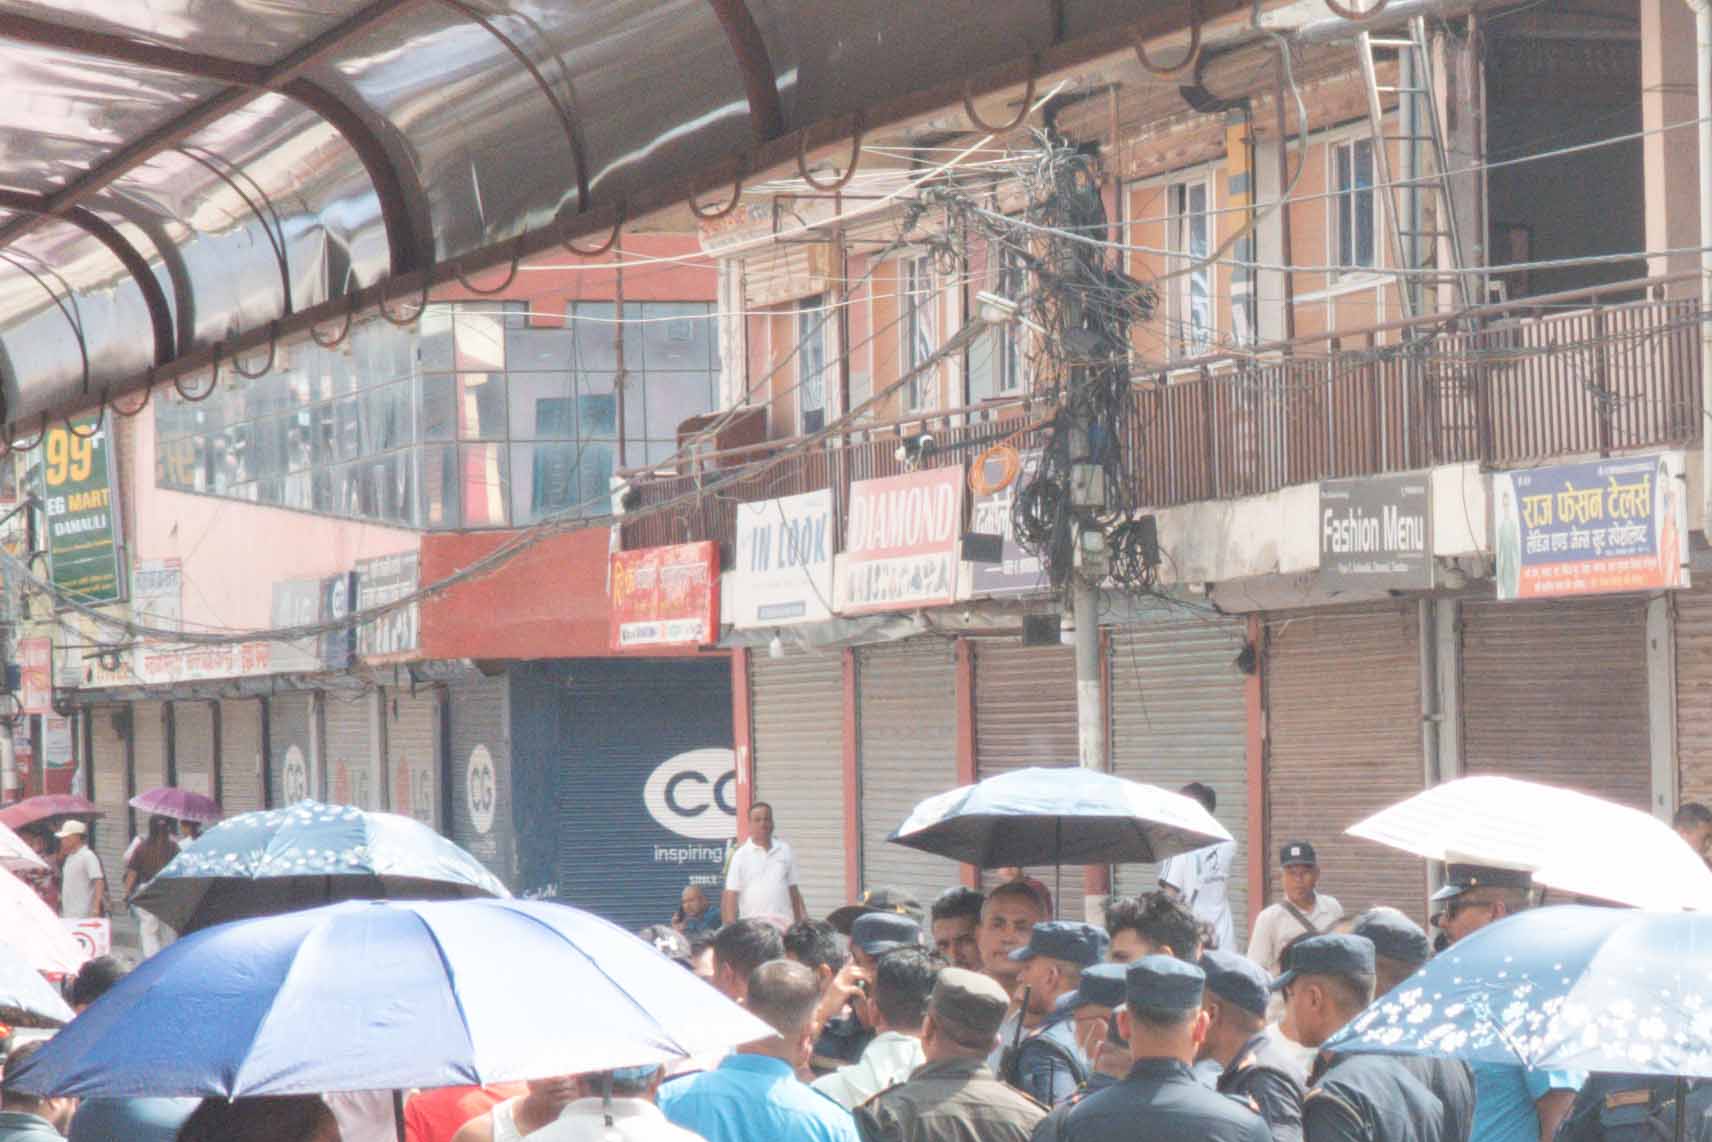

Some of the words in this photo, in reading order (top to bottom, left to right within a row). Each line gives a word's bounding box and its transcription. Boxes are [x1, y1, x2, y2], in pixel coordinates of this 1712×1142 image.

[68, 488, 112, 513] MART
[852, 483, 953, 552] DIAMOND
[777, 511, 827, 569] LOOK
[1323, 507, 1379, 553] Fashion
[1383, 504, 1424, 552] Menu
[471, 766, 494, 812] CG
[654, 843, 723, 864] inspiring
